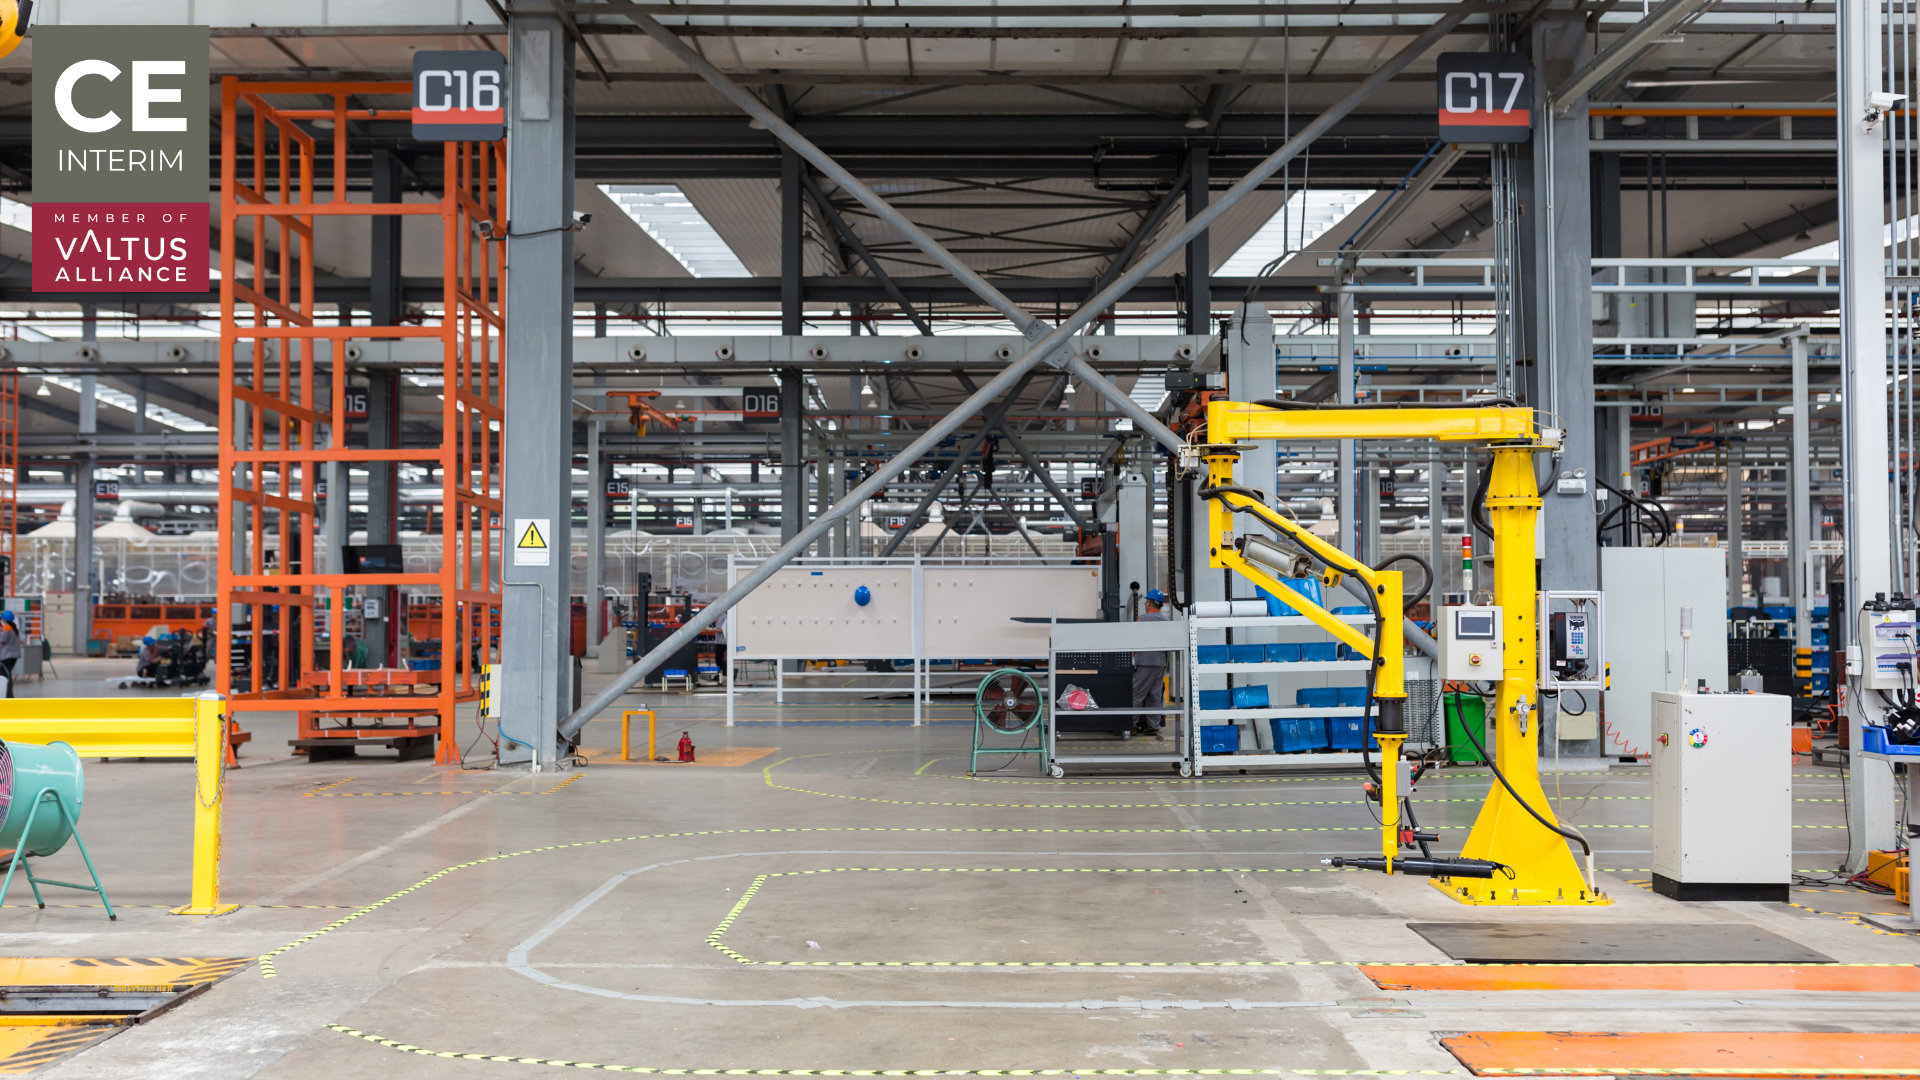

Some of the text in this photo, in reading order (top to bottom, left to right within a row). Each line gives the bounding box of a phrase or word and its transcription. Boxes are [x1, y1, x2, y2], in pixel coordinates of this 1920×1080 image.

[419, 70, 500, 112] C16
[1445, 71, 1525, 114] C17
[744, 394, 779, 412] D16
[607, 482, 629, 494] E15
[1380, 481, 1394, 493] 18
[676, 516, 693, 526] F15
